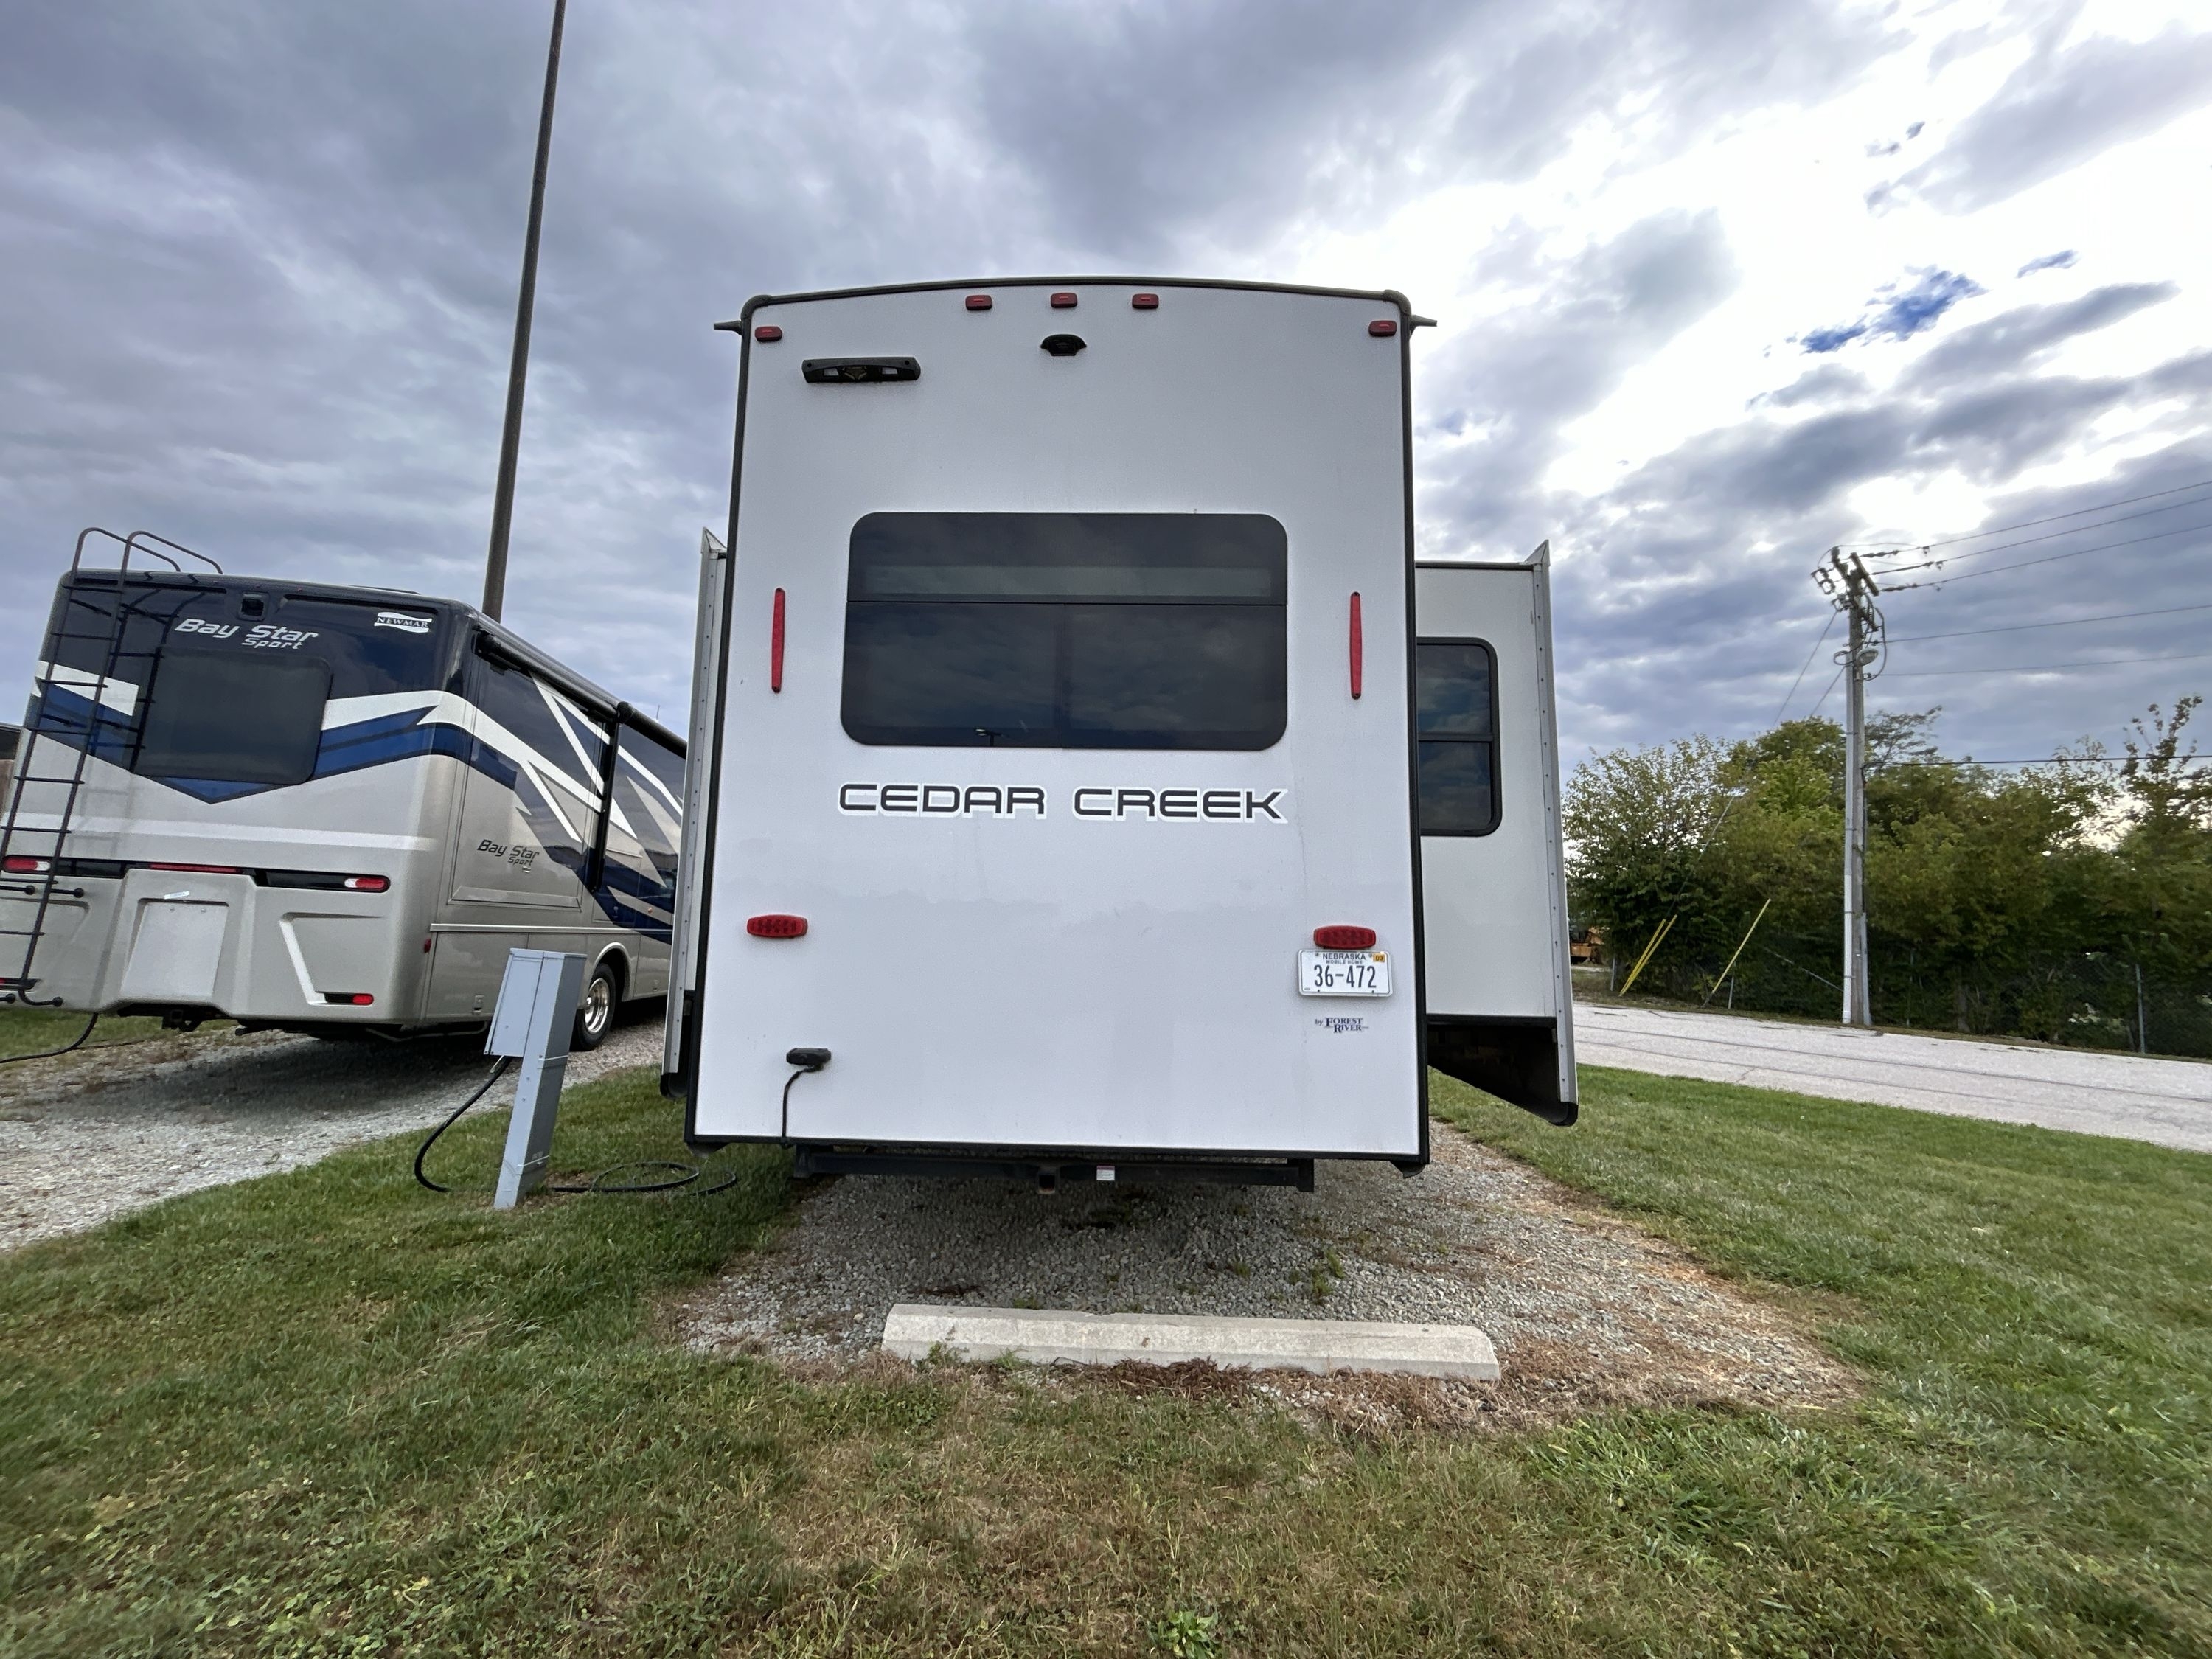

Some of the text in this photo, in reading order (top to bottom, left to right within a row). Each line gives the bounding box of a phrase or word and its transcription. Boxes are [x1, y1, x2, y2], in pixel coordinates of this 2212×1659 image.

[375, 615, 431, 629] NEWMAR
[174, 618, 319, 643] Bay Star
[241, 637, 303, 650] Sport
[838, 783, 1284, 821] CEDAR CREEK
[477, 839, 540, 860] Bay Star
[507, 856, 534, 866] Sport
[1314, 964, 1377, 988] 36-472
[1315, 1018, 1363, 1027] by FOREST
[1333, 1023, 1362, 1034] RIVER
